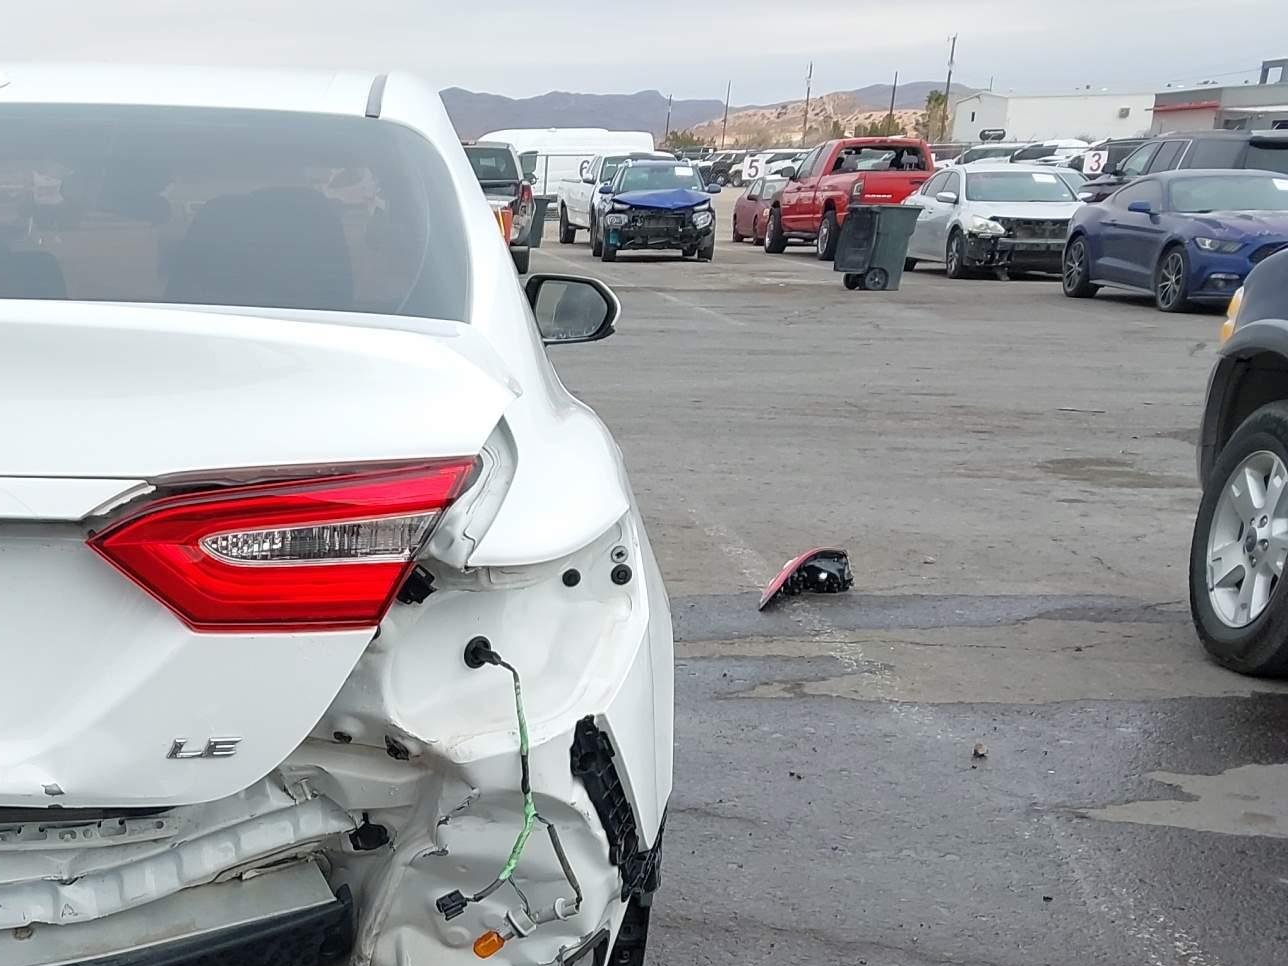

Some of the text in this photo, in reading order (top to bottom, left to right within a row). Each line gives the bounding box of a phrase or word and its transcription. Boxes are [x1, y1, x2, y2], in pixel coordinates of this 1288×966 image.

[747, 159, 760, 178] 5
[1089, 152, 1102, 172] 3
[166, 737, 242, 759] LE
